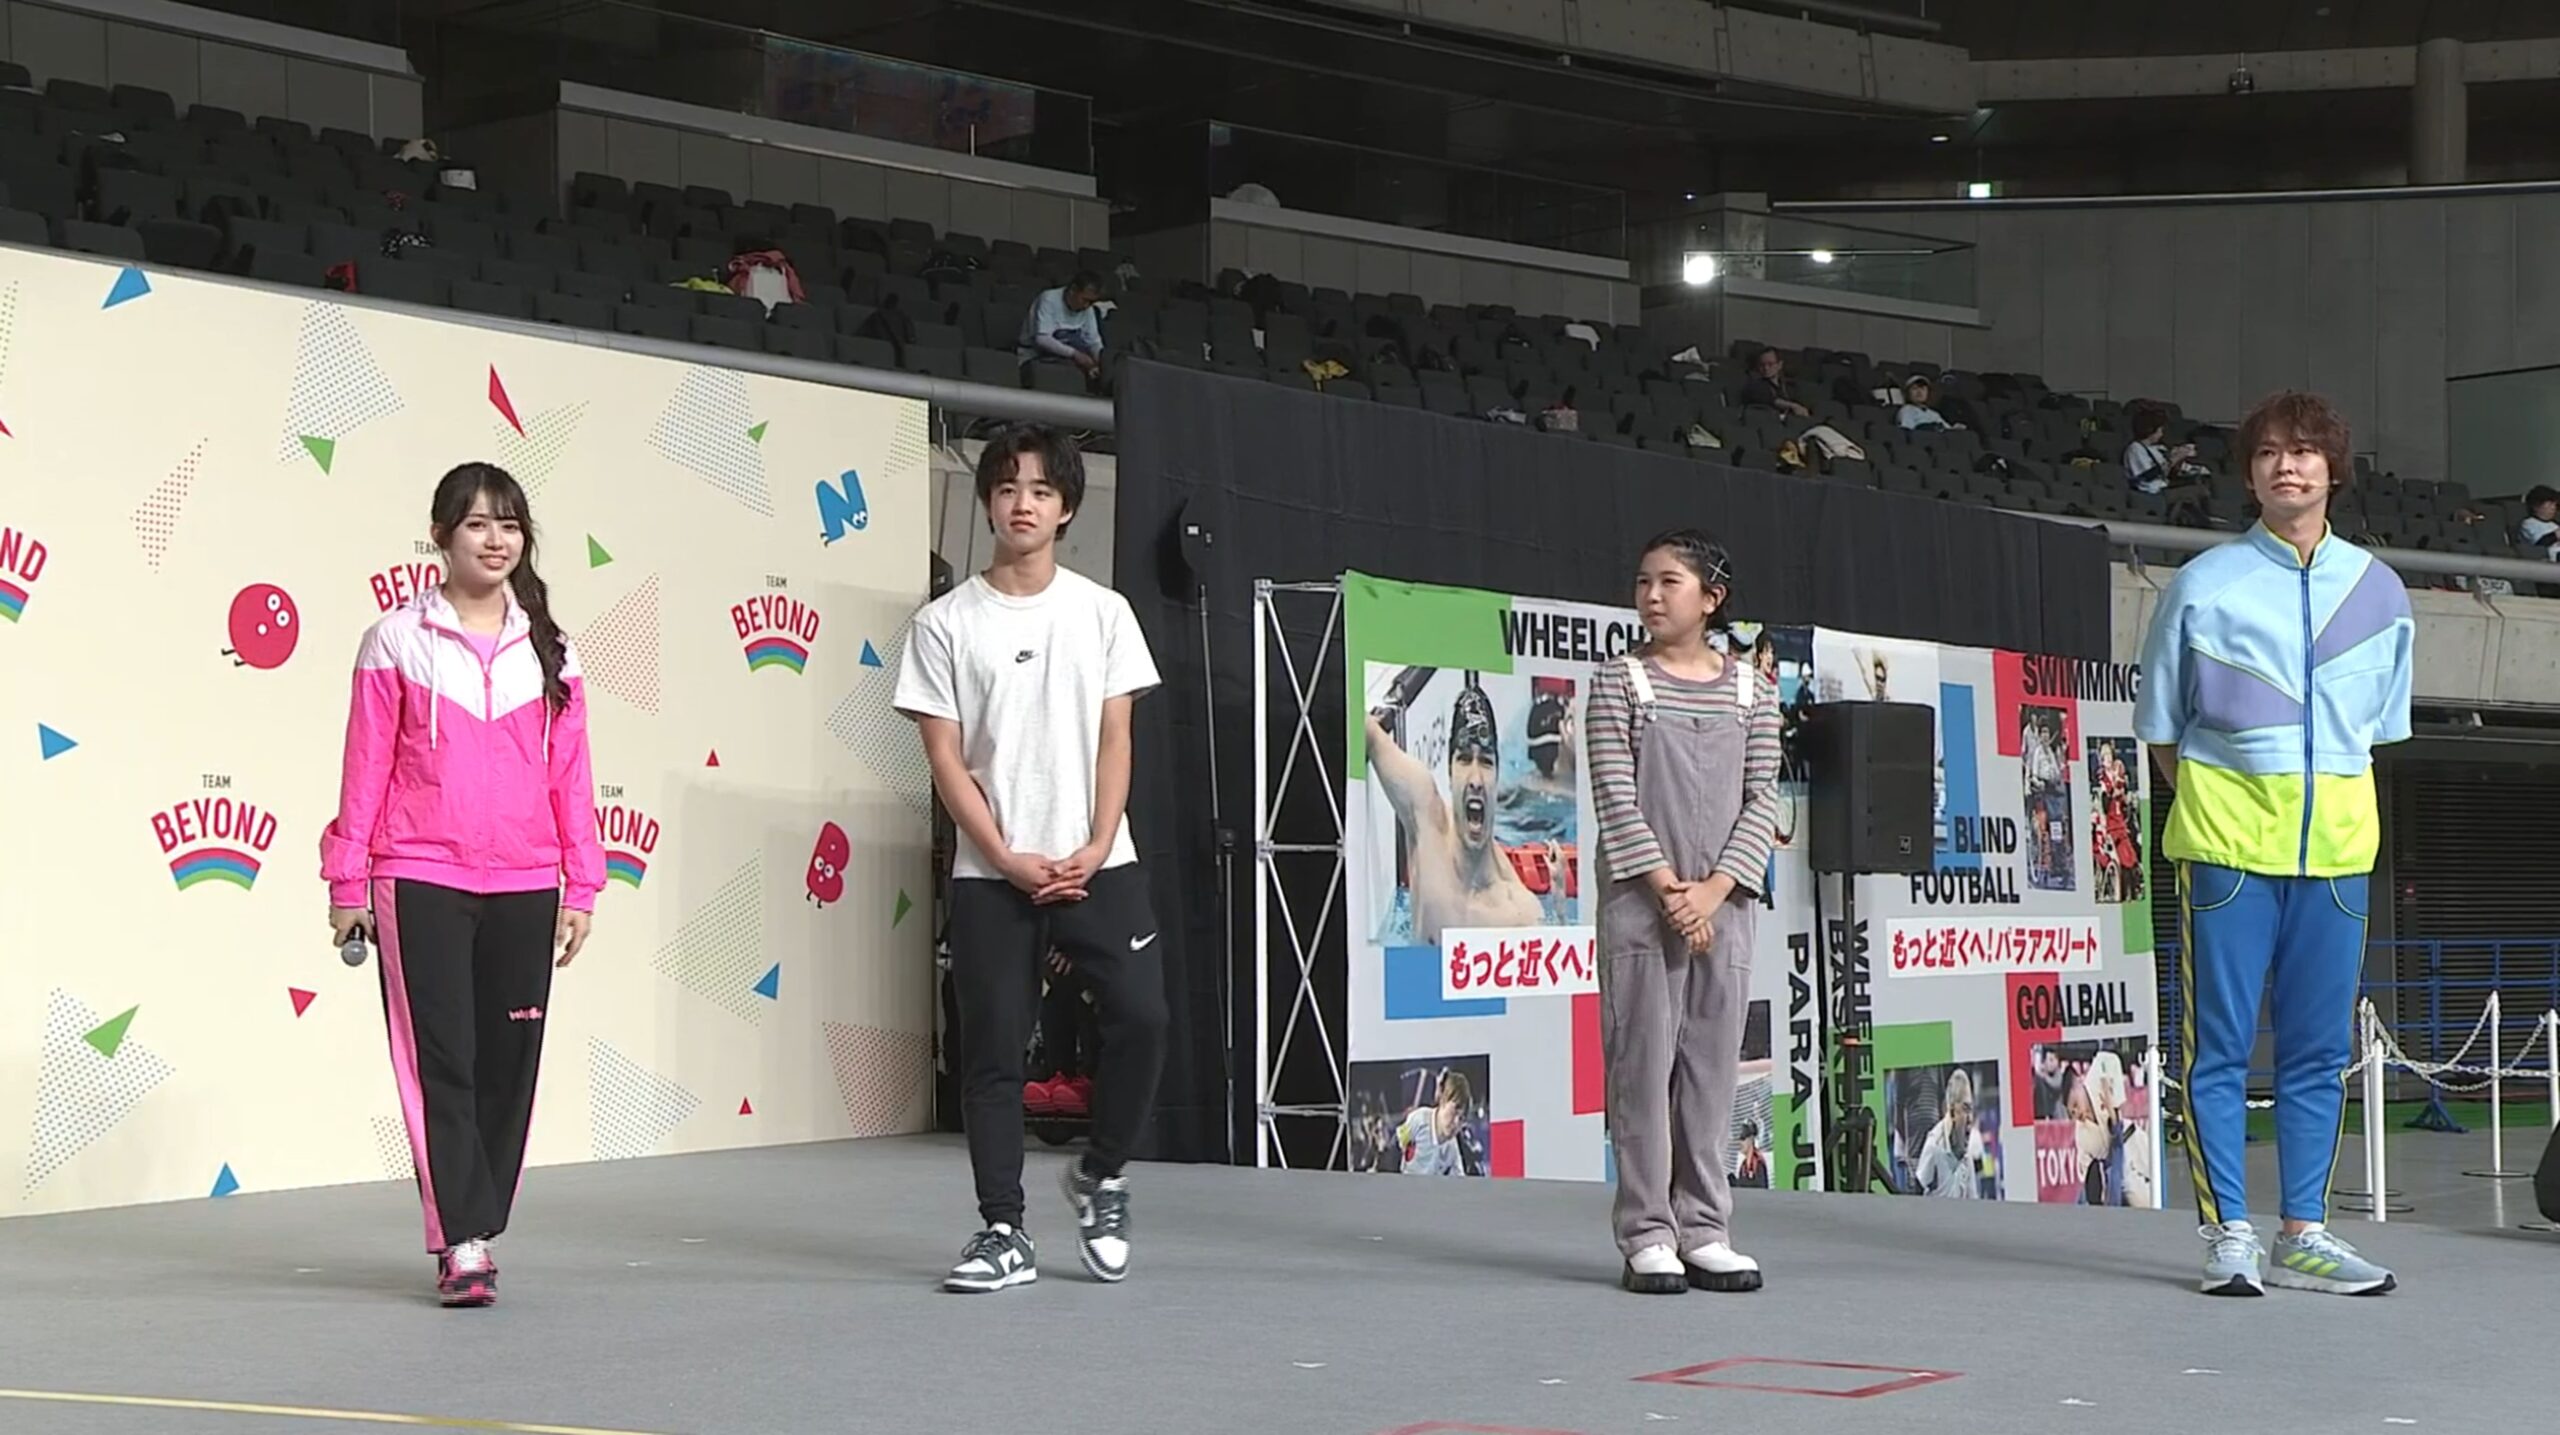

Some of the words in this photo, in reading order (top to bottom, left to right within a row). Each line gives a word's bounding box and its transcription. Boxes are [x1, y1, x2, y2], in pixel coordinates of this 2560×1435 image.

[765, 575, 787, 588] TEAM
[731, 595, 820, 643] BEYOND
[2022, 653, 2142, 703] SWIMMING
[202, 774, 231, 788] TEAM
[600, 785, 624, 798] TEAM
[151, 797, 277, 854] BEYOND
[594, 805, 659, 854] YOND
[1954, 816, 2017, 854] BLIND
[1911, 866, 2020, 904] FOOTBALL
[1788, 932, 1813, 1113] PARA
[2016, 981, 2134, 1030] GOALBALL
